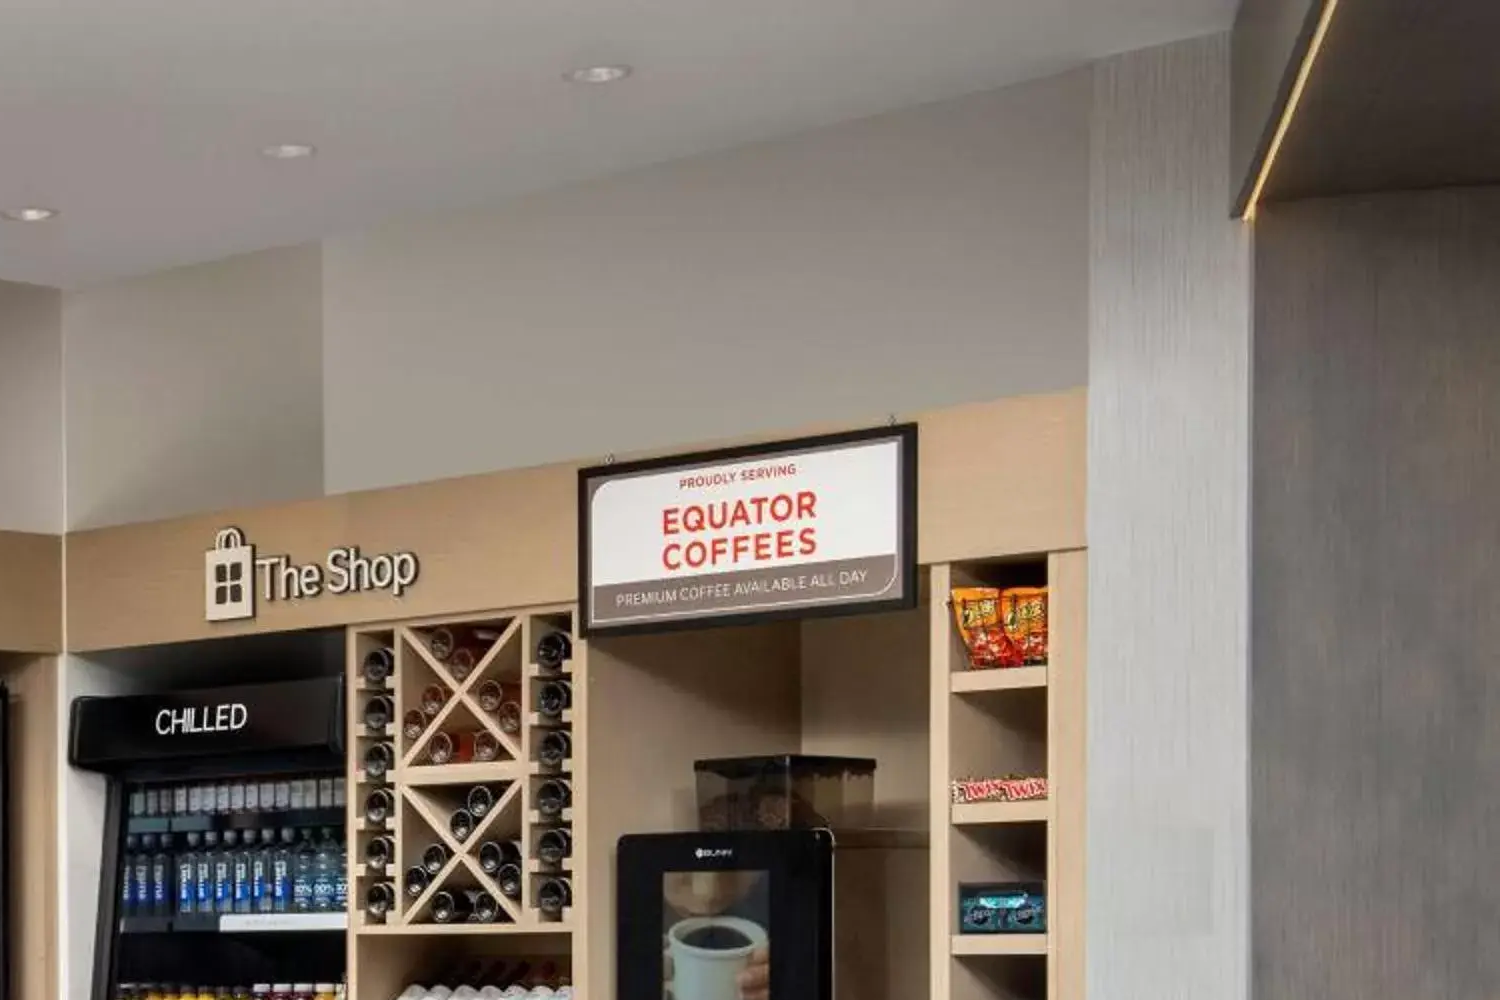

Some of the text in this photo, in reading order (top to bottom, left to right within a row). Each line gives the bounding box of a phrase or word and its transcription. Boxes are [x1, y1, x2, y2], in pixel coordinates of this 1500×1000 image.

[679, 463, 797, 490] PROUDLY SERVING
[662, 490, 817, 536] EQUATOR
[662, 527, 817, 570] COFFEES
[255, 547, 419, 602] The Shop
[615, 568, 869, 608] PREMIUM COFFEE AVAILABLE ALL DAY
[155, 703, 248, 735] CHILLED
